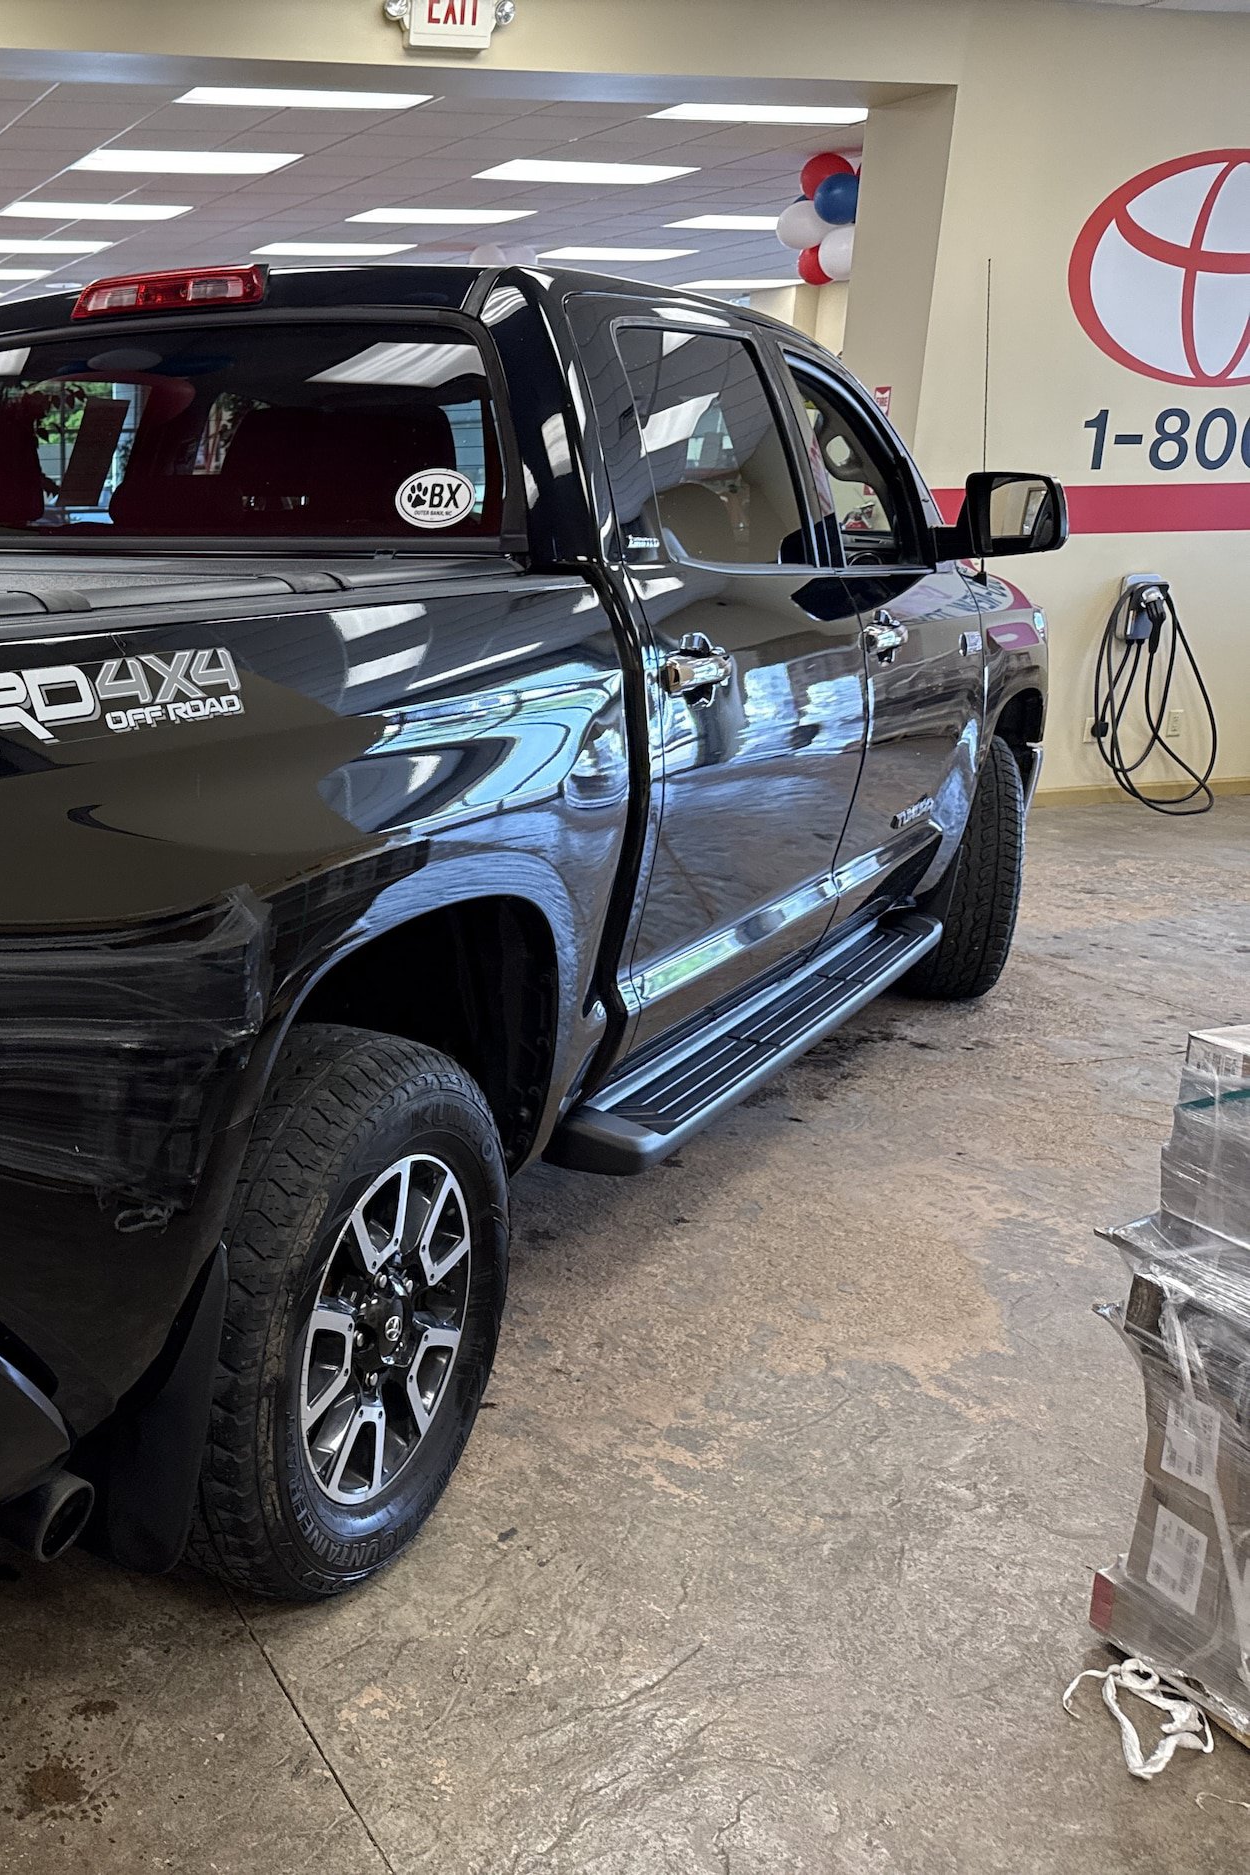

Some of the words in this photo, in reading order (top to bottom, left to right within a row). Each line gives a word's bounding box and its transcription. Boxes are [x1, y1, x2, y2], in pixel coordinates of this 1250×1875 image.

[1084, 407, 1250, 471] 1-80
[105, 705, 166, 734] OFF
[167, 694, 245, 724] ROAD
